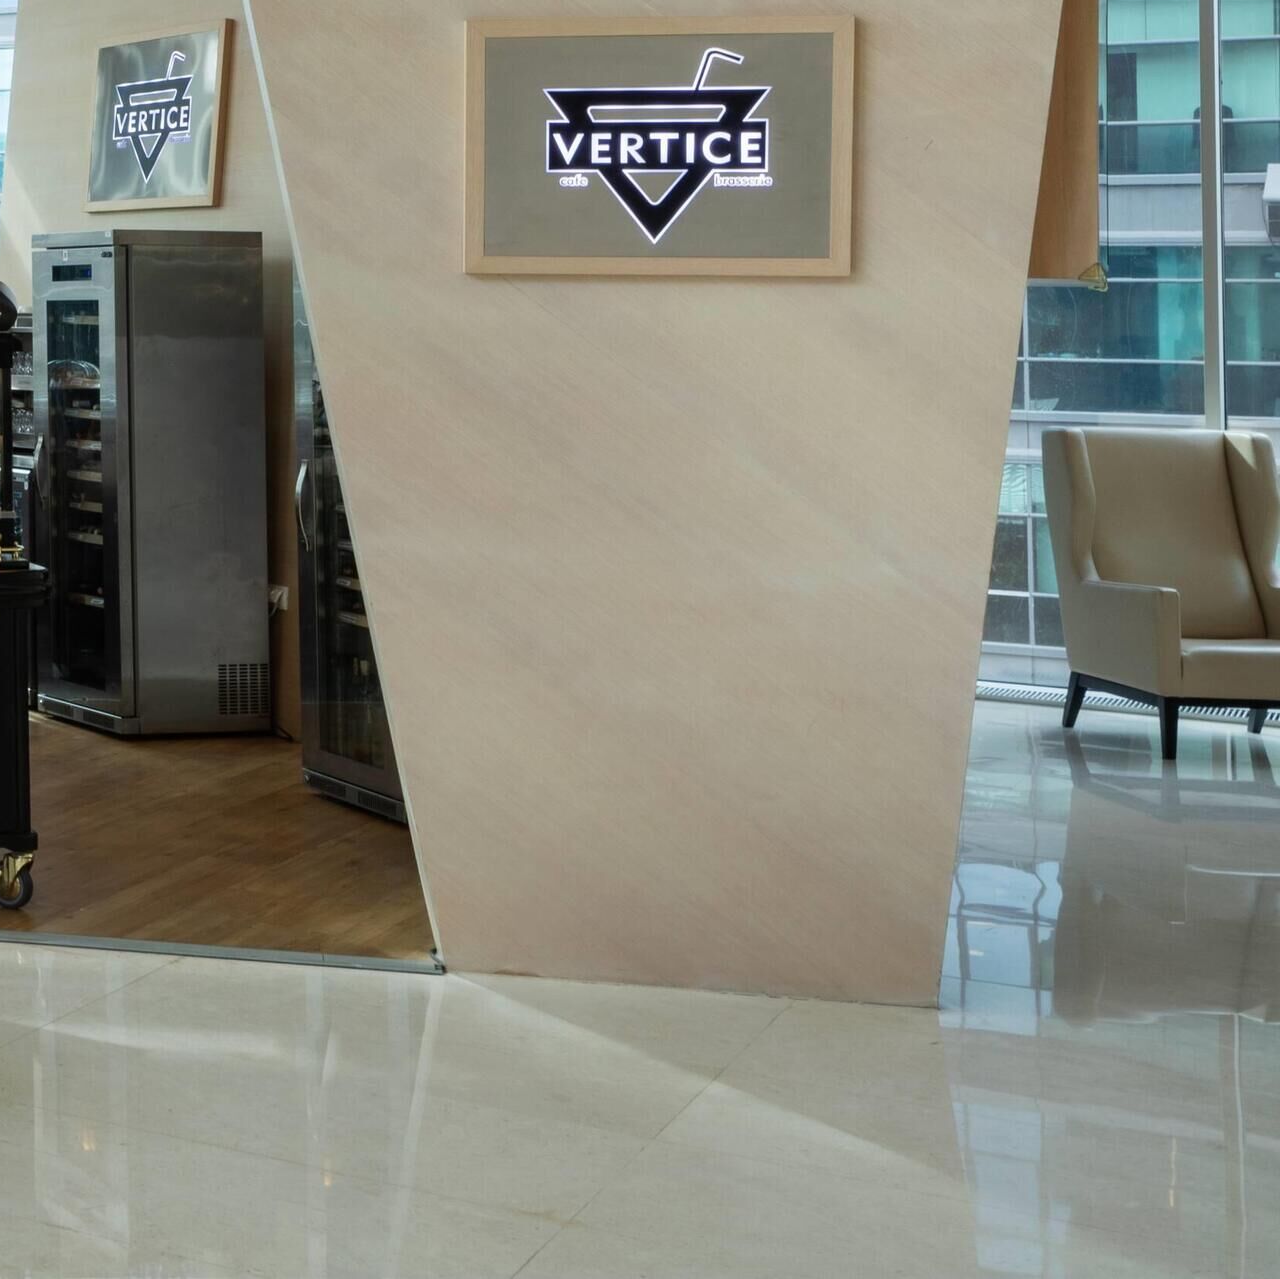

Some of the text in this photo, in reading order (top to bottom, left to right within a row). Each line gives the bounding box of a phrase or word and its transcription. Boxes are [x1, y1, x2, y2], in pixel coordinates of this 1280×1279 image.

[117, 106, 188, 133] VERTICE
[552, 132, 761, 164] VERTICE
[714, 174, 773, 187] brasserie
